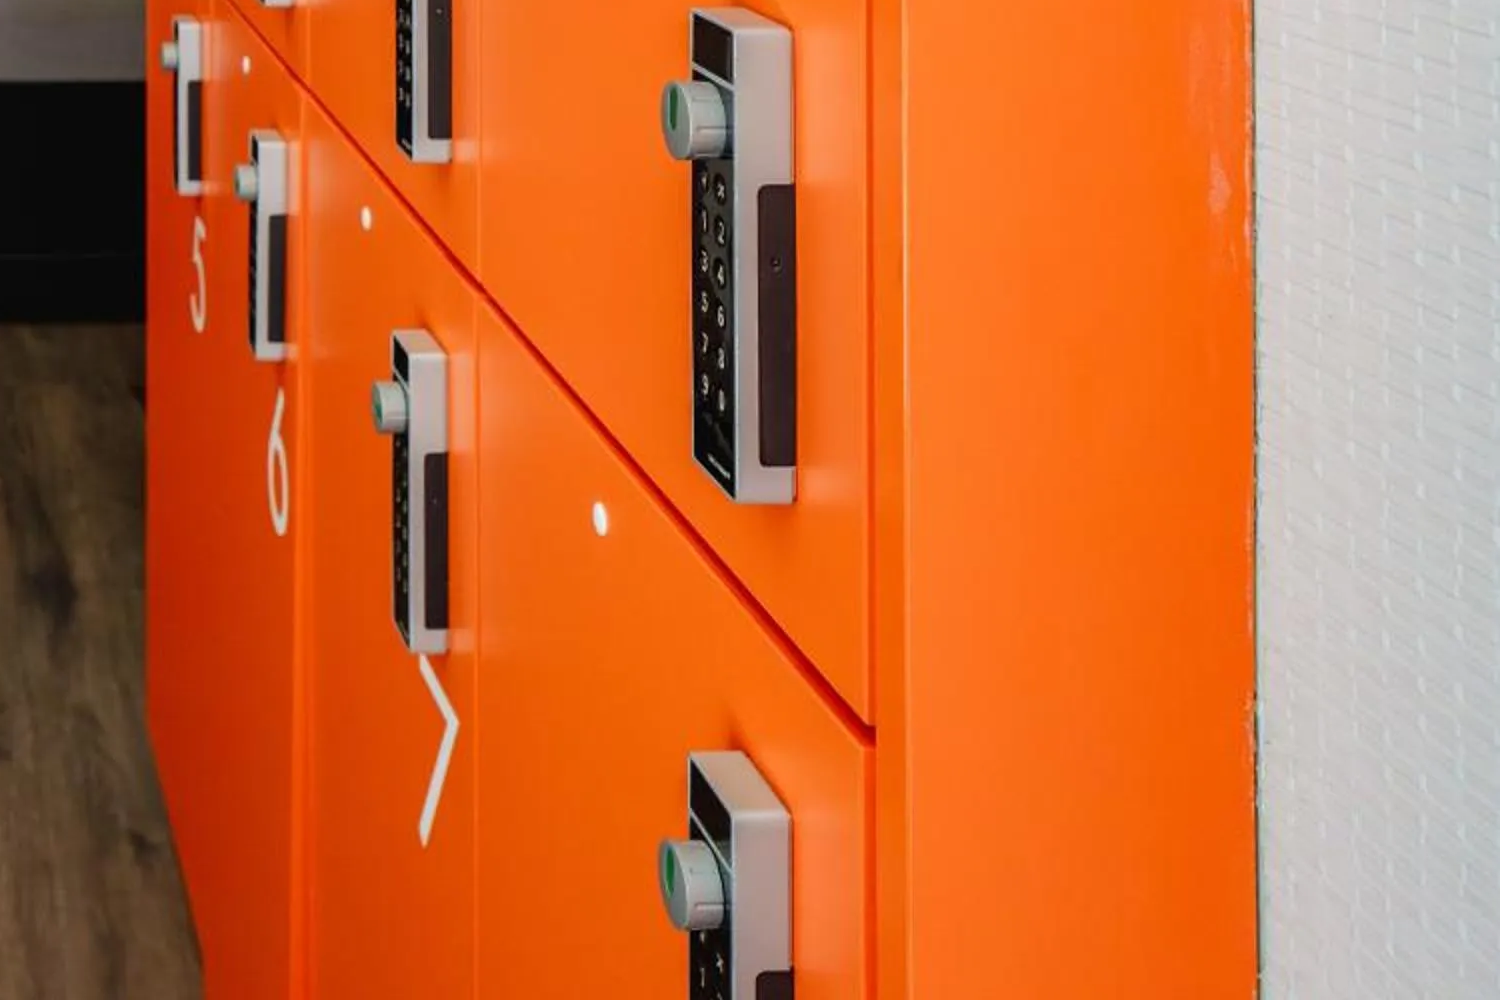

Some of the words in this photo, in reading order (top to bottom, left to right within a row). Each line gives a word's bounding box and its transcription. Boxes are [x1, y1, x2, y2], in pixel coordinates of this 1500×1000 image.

[189, 215, 207, 334] 5
[267, 386, 289, 537] 6
[419, 652, 461, 849] 7
